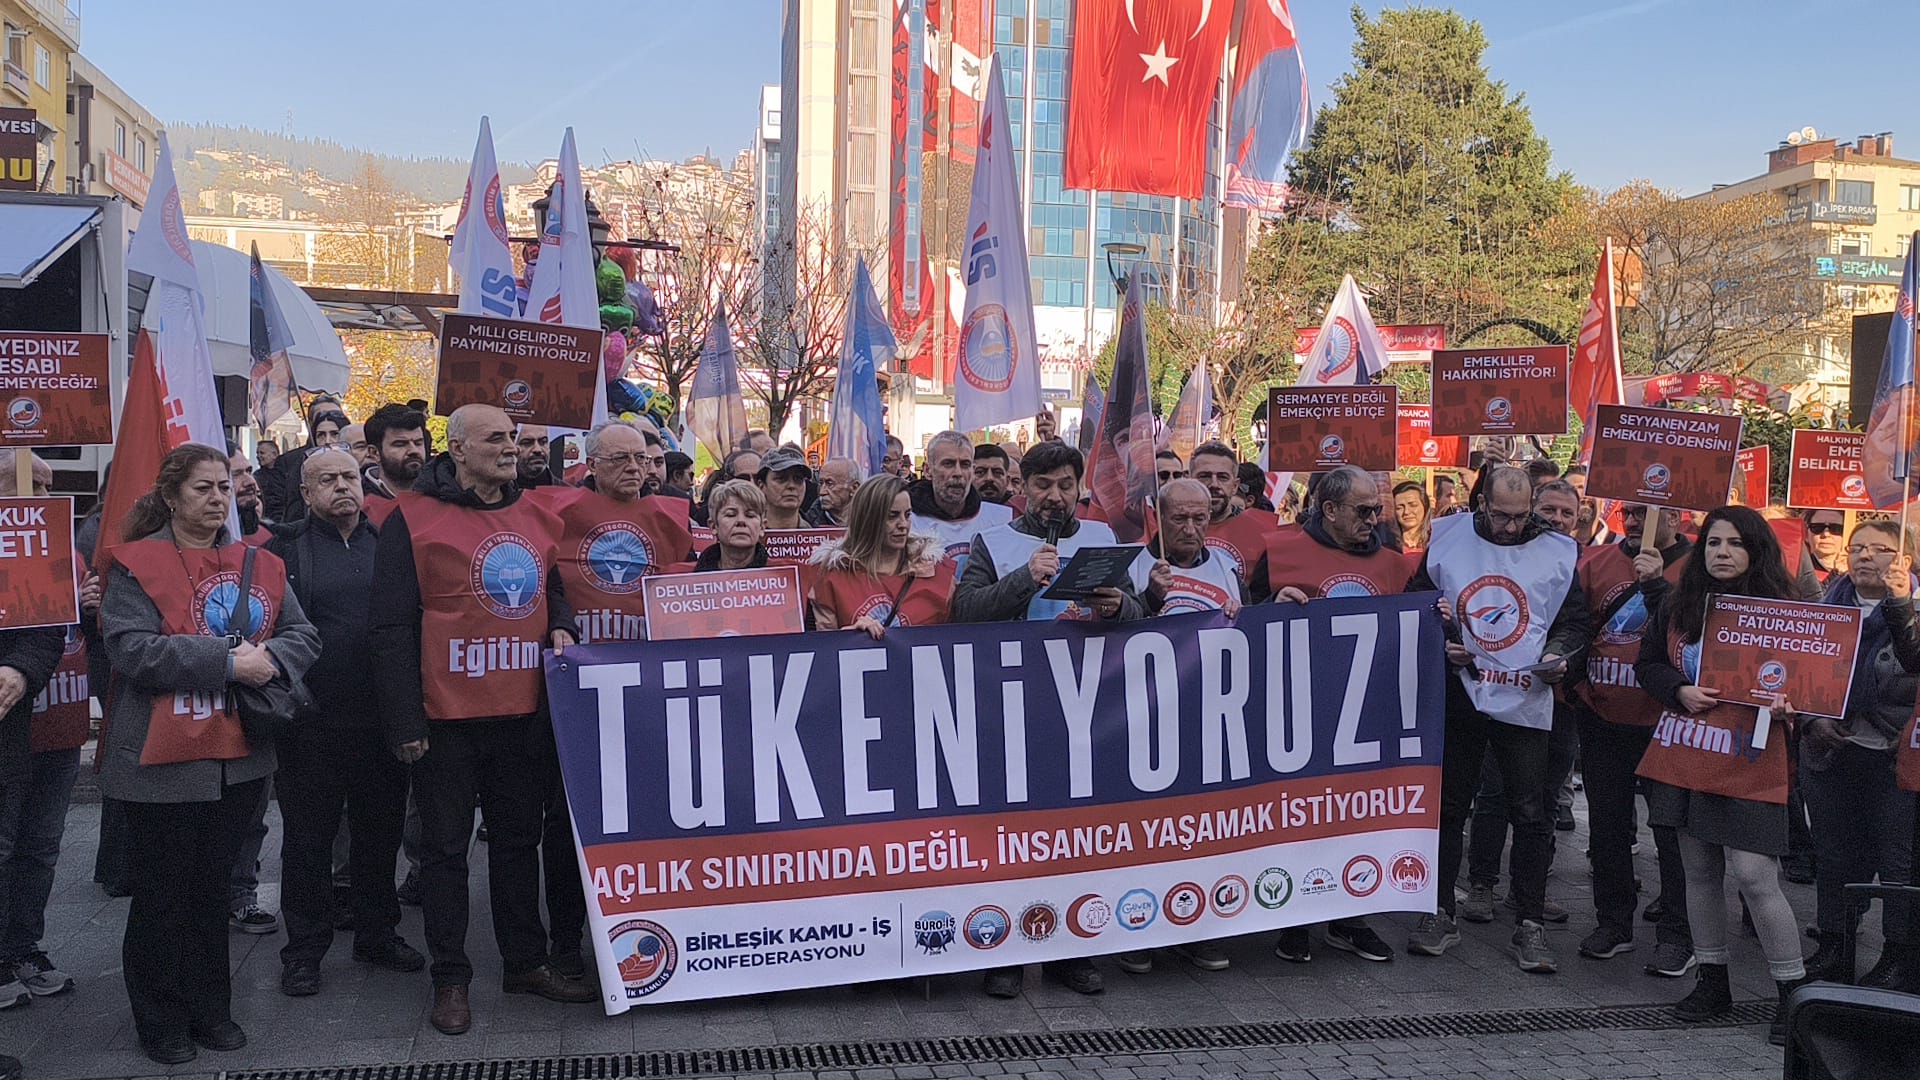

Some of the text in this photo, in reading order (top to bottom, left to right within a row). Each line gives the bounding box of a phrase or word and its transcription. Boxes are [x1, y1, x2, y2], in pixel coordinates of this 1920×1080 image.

[469, 324, 577, 348] MİLLİ GELİRDEN
[0, 338, 80, 356] YEDİNİZ
[450, 337, 591, 363] PAYIMIZI İSTİYORUZ!
[1463, 355, 1535, 368] EMEKLİLER
[1442, 367, 1556, 381] HAKKINI İSTİYOR!
[1276, 390, 1389, 405] SERMAYEYE DEĞİL
[1280, 404, 1385, 419] EMEKÇİYE BÜTÇE
[1619, 413, 1720, 434] SEYYANEN ZAM
[1602, 427, 1732, 451] EMEKLİYE ÖDENSİN!
[1816, 435, 1851, 445] HALKIN
[1829, 446, 1863, 457] EME
[766, 534, 796, 545] ASGARİ
[655, 580, 725, 598] DEVLETİN
[726, 577, 787, 592] MEMURU
[660, 593, 785, 614] YOKSUL OLAMAZ!
[1715, 601, 1853, 623] SORUMLUSU OLMADIĞIMIZ KRİZİN
[1738, 615, 1826, 636] FATURASINI
[1716, 626, 1841, 656] ÖDEMEYECEĞİZ!
[449, 637, 539, 678] Eğitim
[592, 784, 1426, 903] AÇLIK SINIRINDA DEĞİL, İNSANCA YAŞAMAK İSTİYORUZ
[685, 925, 784, 955] BİRLEŞİK
[788, 922, 854, 944] KAMU
[871, 916, 892, 939] İŞ
[686, 943, 866, 973] KONFEDERASYONU
